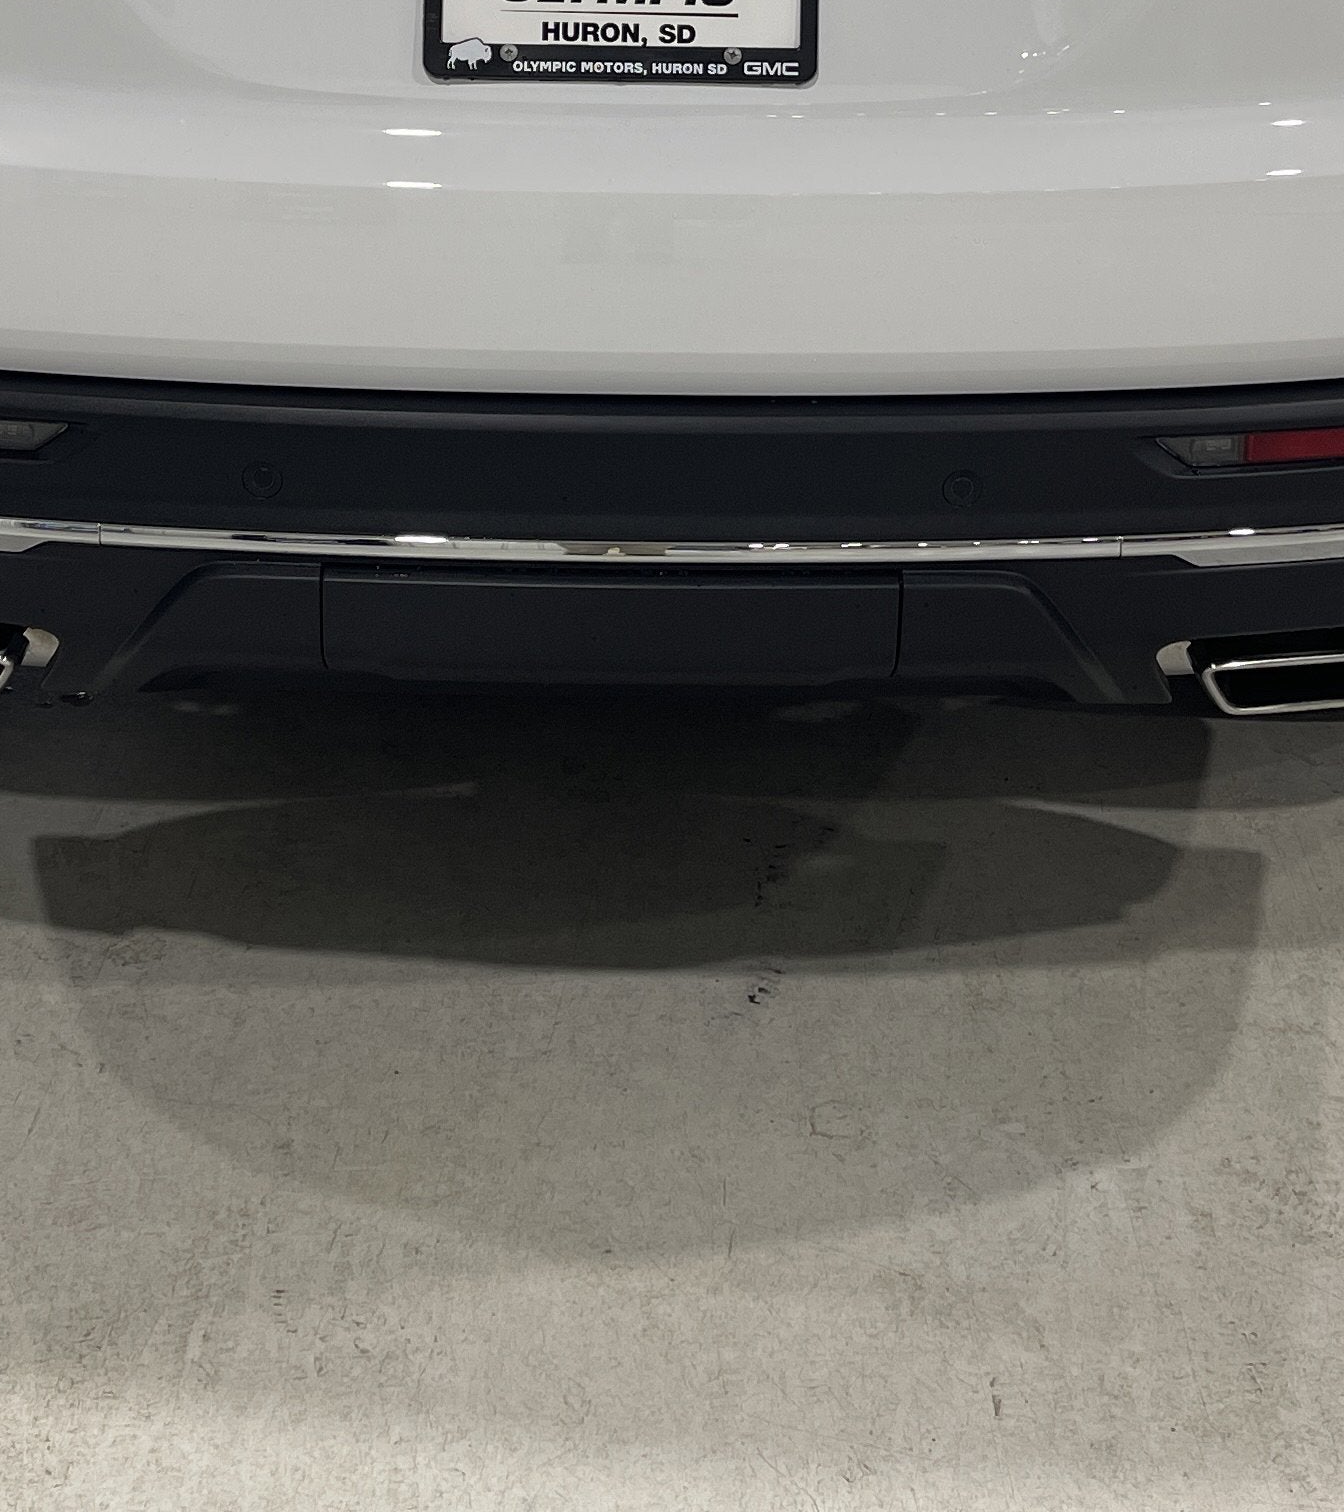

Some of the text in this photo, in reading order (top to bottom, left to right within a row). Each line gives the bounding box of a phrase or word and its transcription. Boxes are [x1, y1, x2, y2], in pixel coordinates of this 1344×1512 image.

[542, 22, 696, 46] HURON, SD
[513, 61, 728, 76] OLYMPIC MOTORS, HURON SD
[743, 62, 800, 77] GMC
